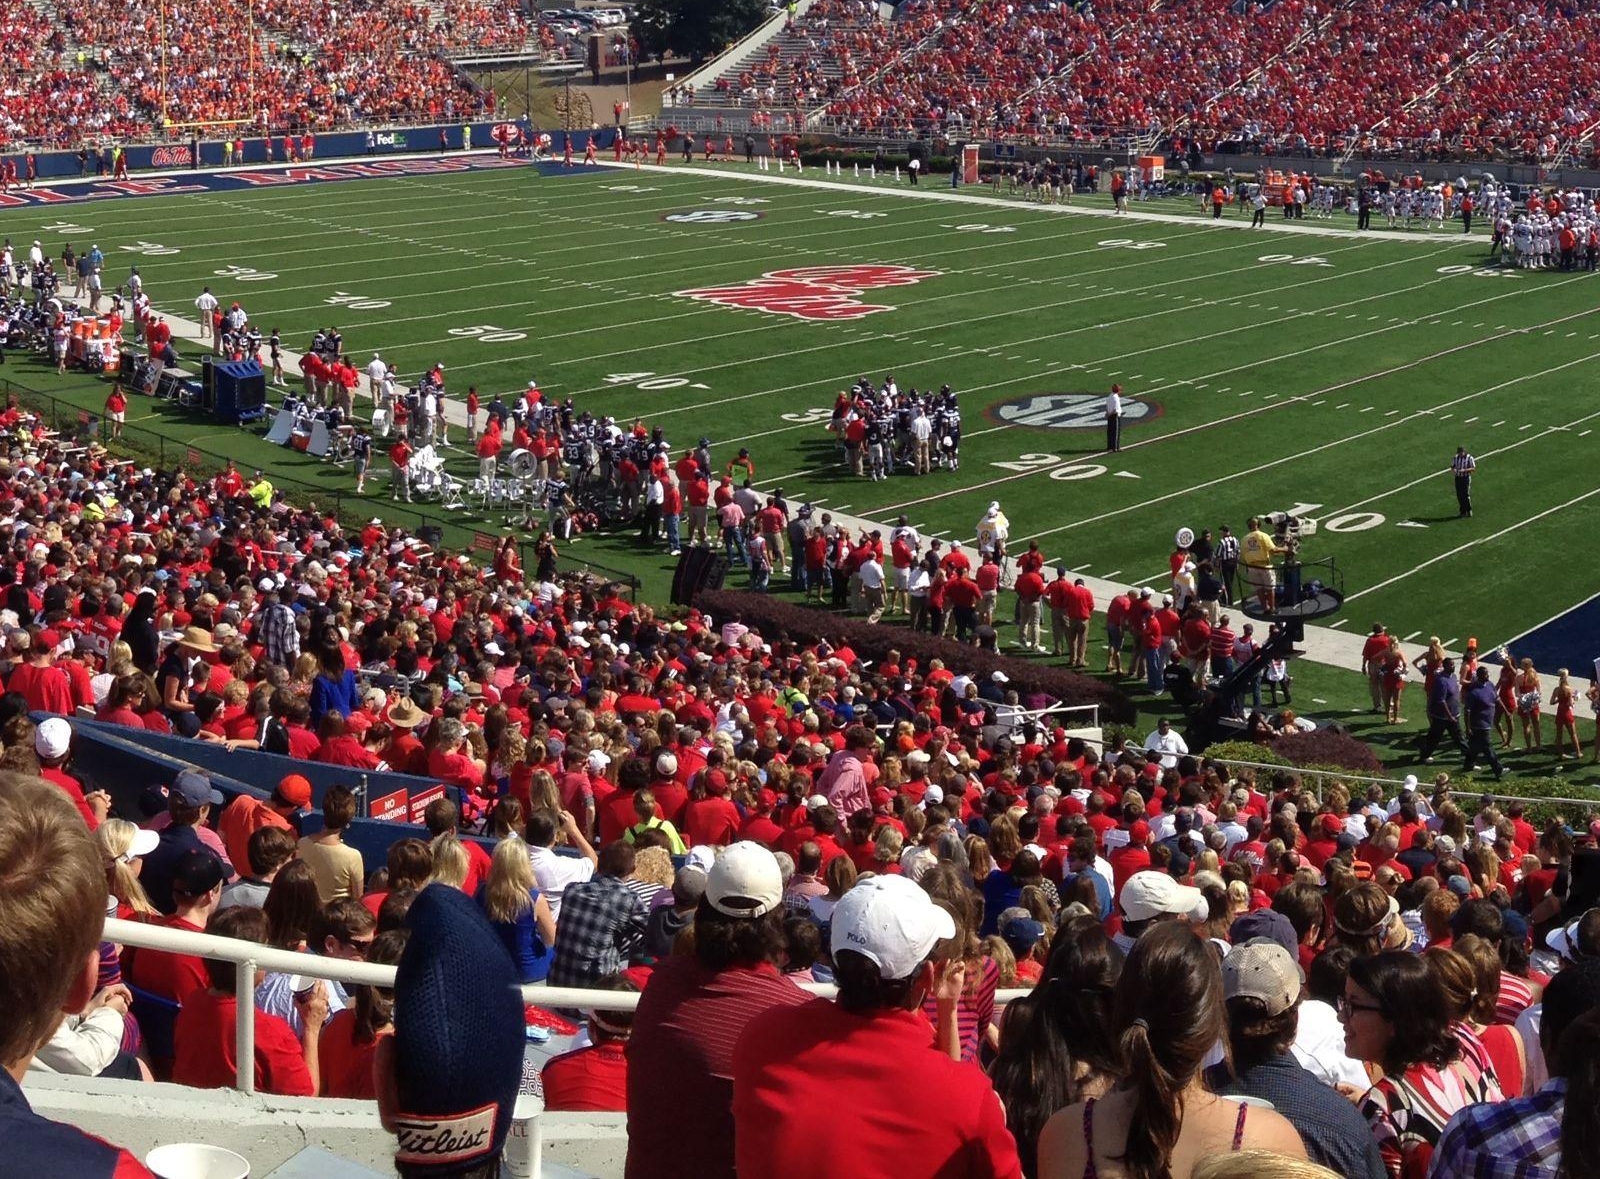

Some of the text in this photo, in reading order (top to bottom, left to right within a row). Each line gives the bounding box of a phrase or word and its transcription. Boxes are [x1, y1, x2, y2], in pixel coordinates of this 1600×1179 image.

[376, 132, 406, 146] FedEx
[151, 147, 171, 166] Ole
[215, 155, 537, 185] MISS
[448, 325, 528, 342] 50
[603, 371, 691, 390] 40
[780, 408, 833, 422] 3
[567, 446, 578, 459] 33
[989, 453, 1108, 481] 20
[1283, 502, 1386, 532] 10
[385, 798, 396, 811] NO
[847, 932, 866, 944] POLO
[399, 1123, 489, 1154] Titleist
